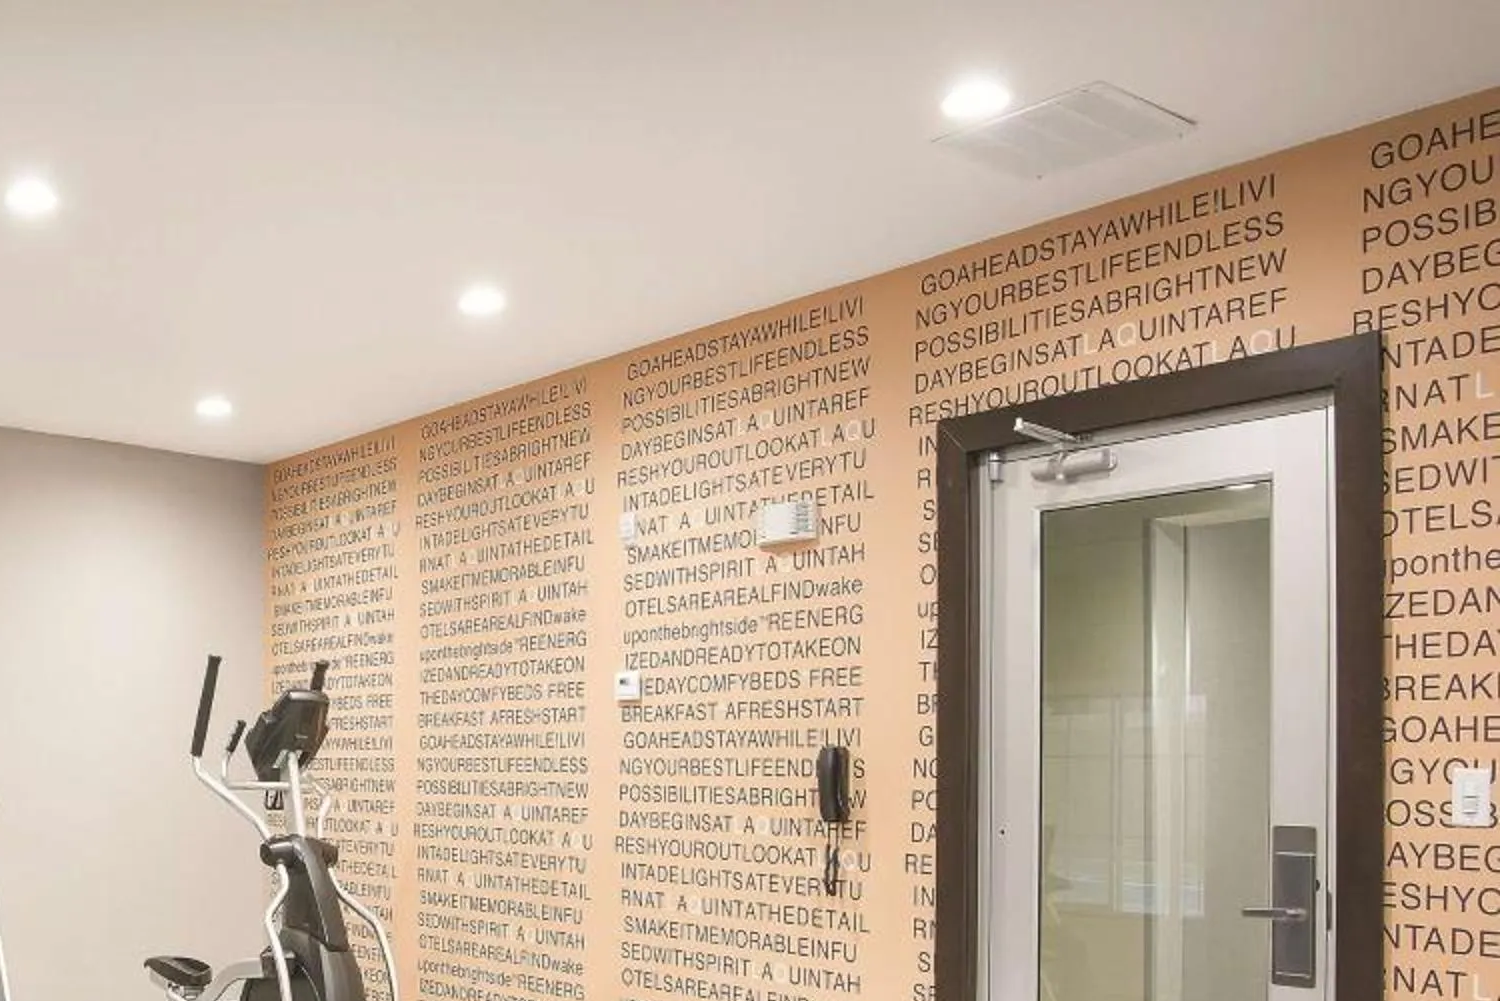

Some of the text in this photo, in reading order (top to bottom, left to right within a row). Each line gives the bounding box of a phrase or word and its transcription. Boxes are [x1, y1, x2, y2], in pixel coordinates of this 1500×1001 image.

[1371, 108, 1500, 171] GOAHE
[1363, 154, 1492, 214] NGYOU
[921, 173, 1275, 296] GOAHEADSTAYAWHILE!LIVI
[1363, 196, 1496, 255] POSSIB
[916, 210, 1283, 329] NGYOURBESTLIFEENDLESS
[915, 249, 1285, 361] POSSIBILITIESABRIGHTNEW
[915, 288, 1287, 393] DAYBEGINSATLAQUINTAREF
[1381, 500, 1500, 538] OTELS
[619, 758, 865, 781] NGYOURBESTLIFEENDS
